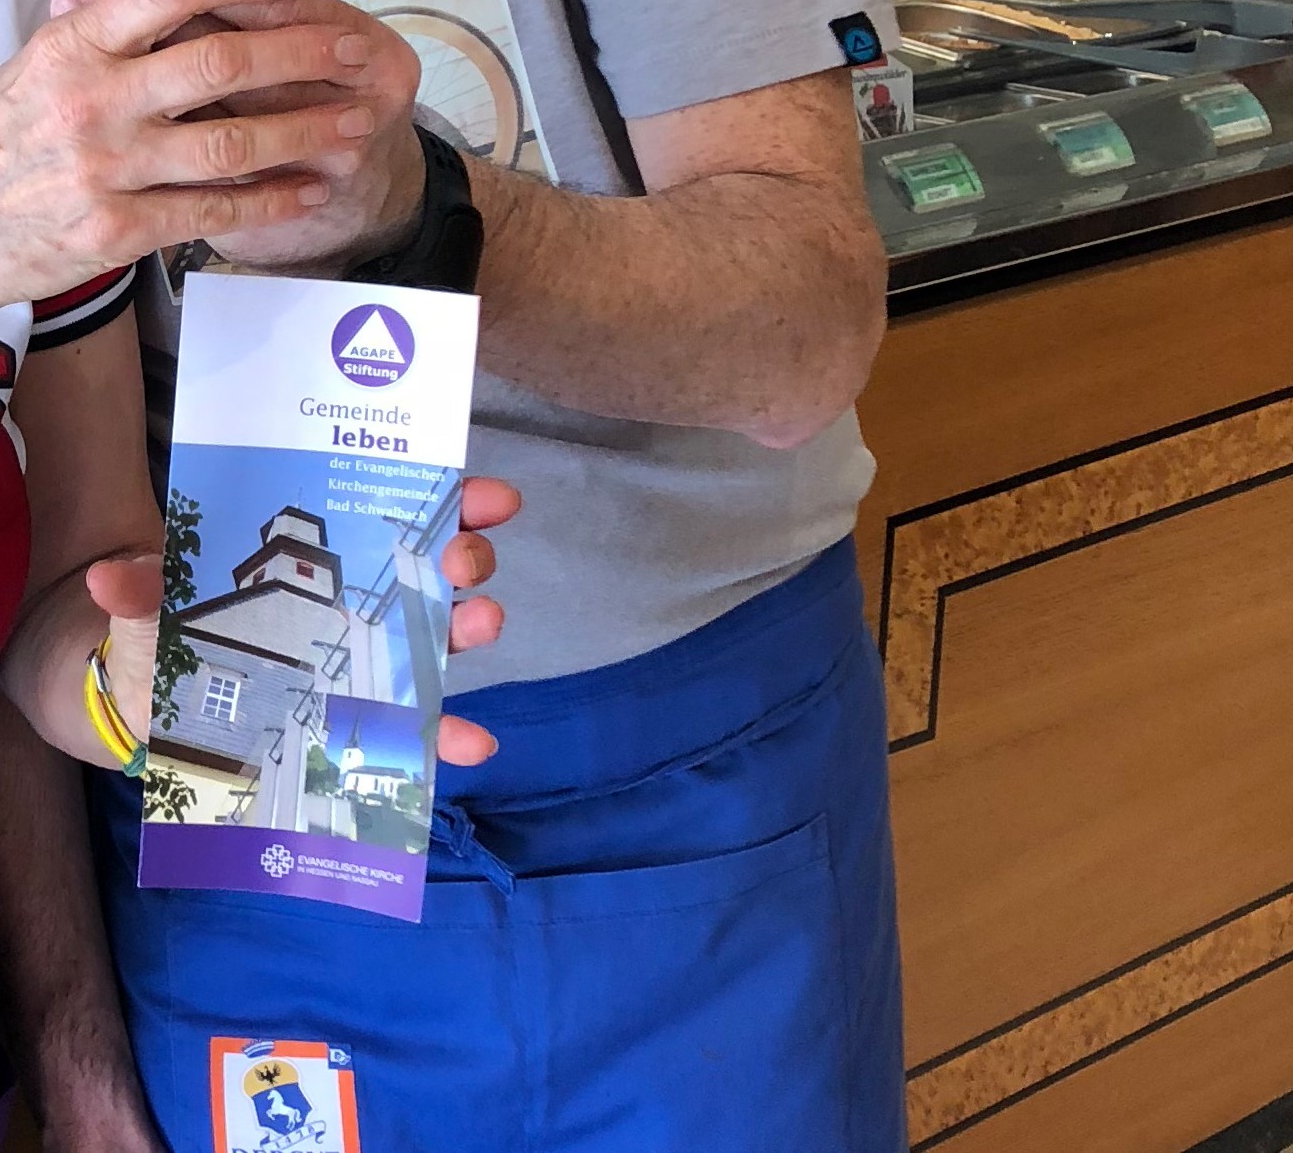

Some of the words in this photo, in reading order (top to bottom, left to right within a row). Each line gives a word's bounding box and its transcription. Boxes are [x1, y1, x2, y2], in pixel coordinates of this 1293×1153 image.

[350, 346, 396, 360] AGAPE
[343, 363, 399, 381] Stiftung
[299, 397, 411, 426] Gemeinde
[332, 425, 409, 453] leben
[329, 457, 352, 470] der
[355, 460, 446, 482] Evangelischen
[328, 478, 440, 503] Kirchengemeinde
[326, 499, 350, 513] Bad
[353, 502, 428, 523] Schwalbach
[298, 855, 368, 875] EVANGELISCHE
[369, 868, 404, 884] KIRCHE
